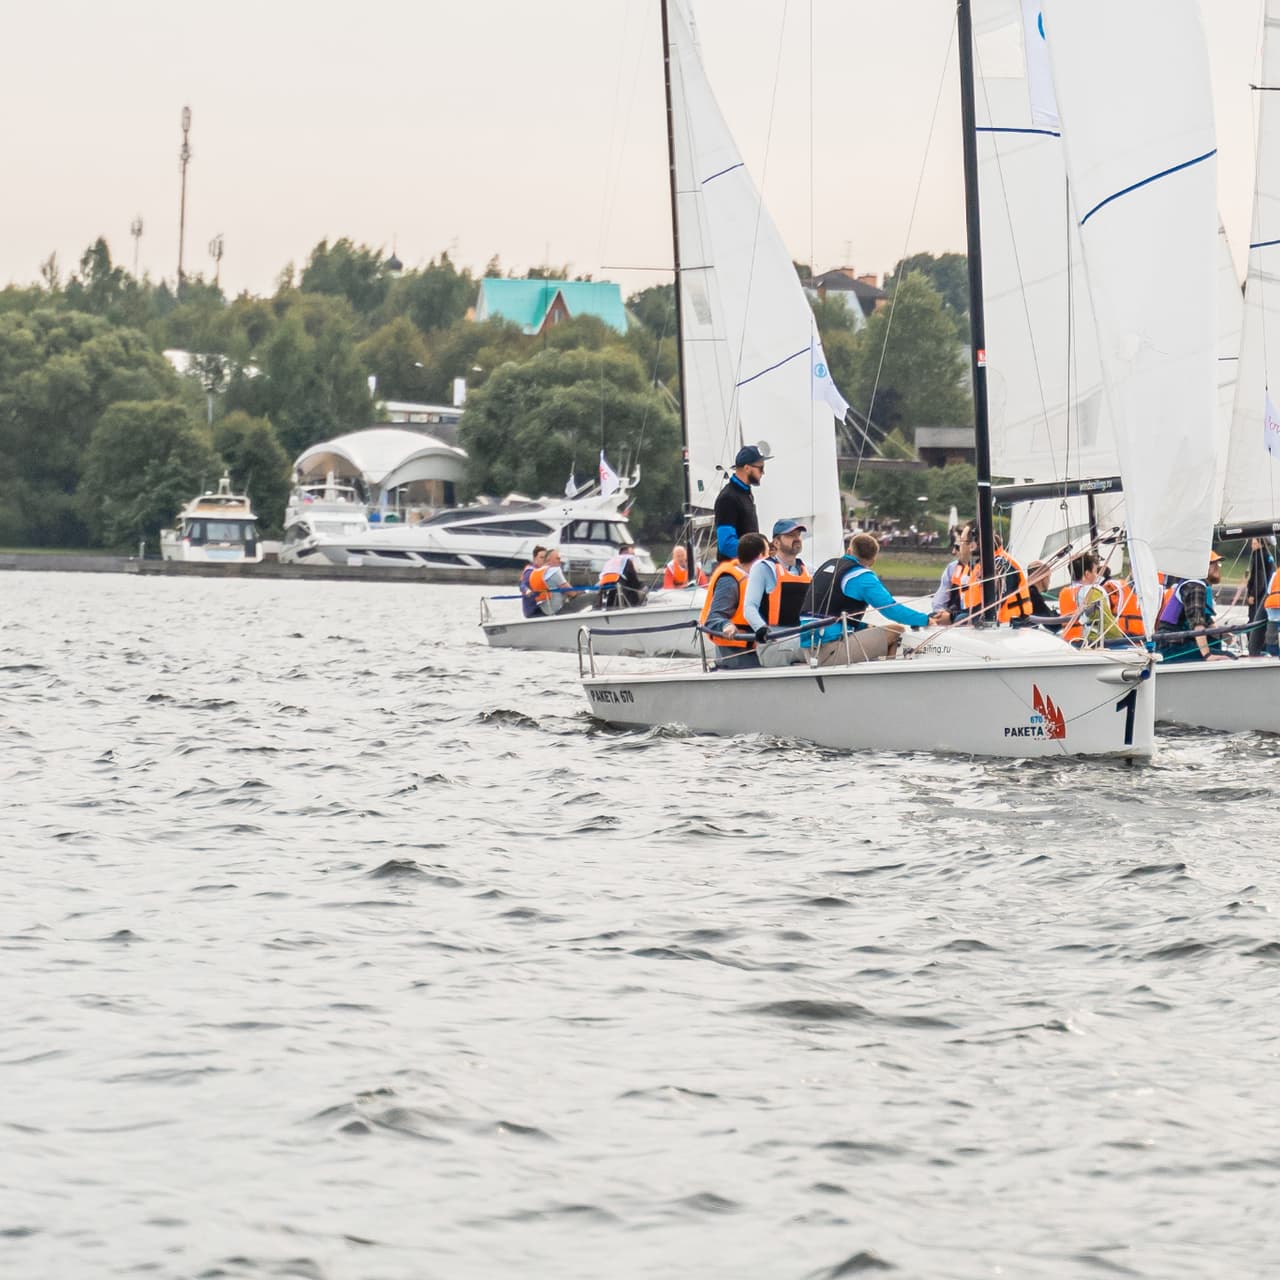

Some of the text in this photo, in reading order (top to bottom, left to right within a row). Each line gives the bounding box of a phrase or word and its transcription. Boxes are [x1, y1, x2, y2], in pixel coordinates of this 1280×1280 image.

[620, 690, 635, 704] 670
[1030, 715, 1043, 724] 670
[1115, 688, 1137, 745] 1
